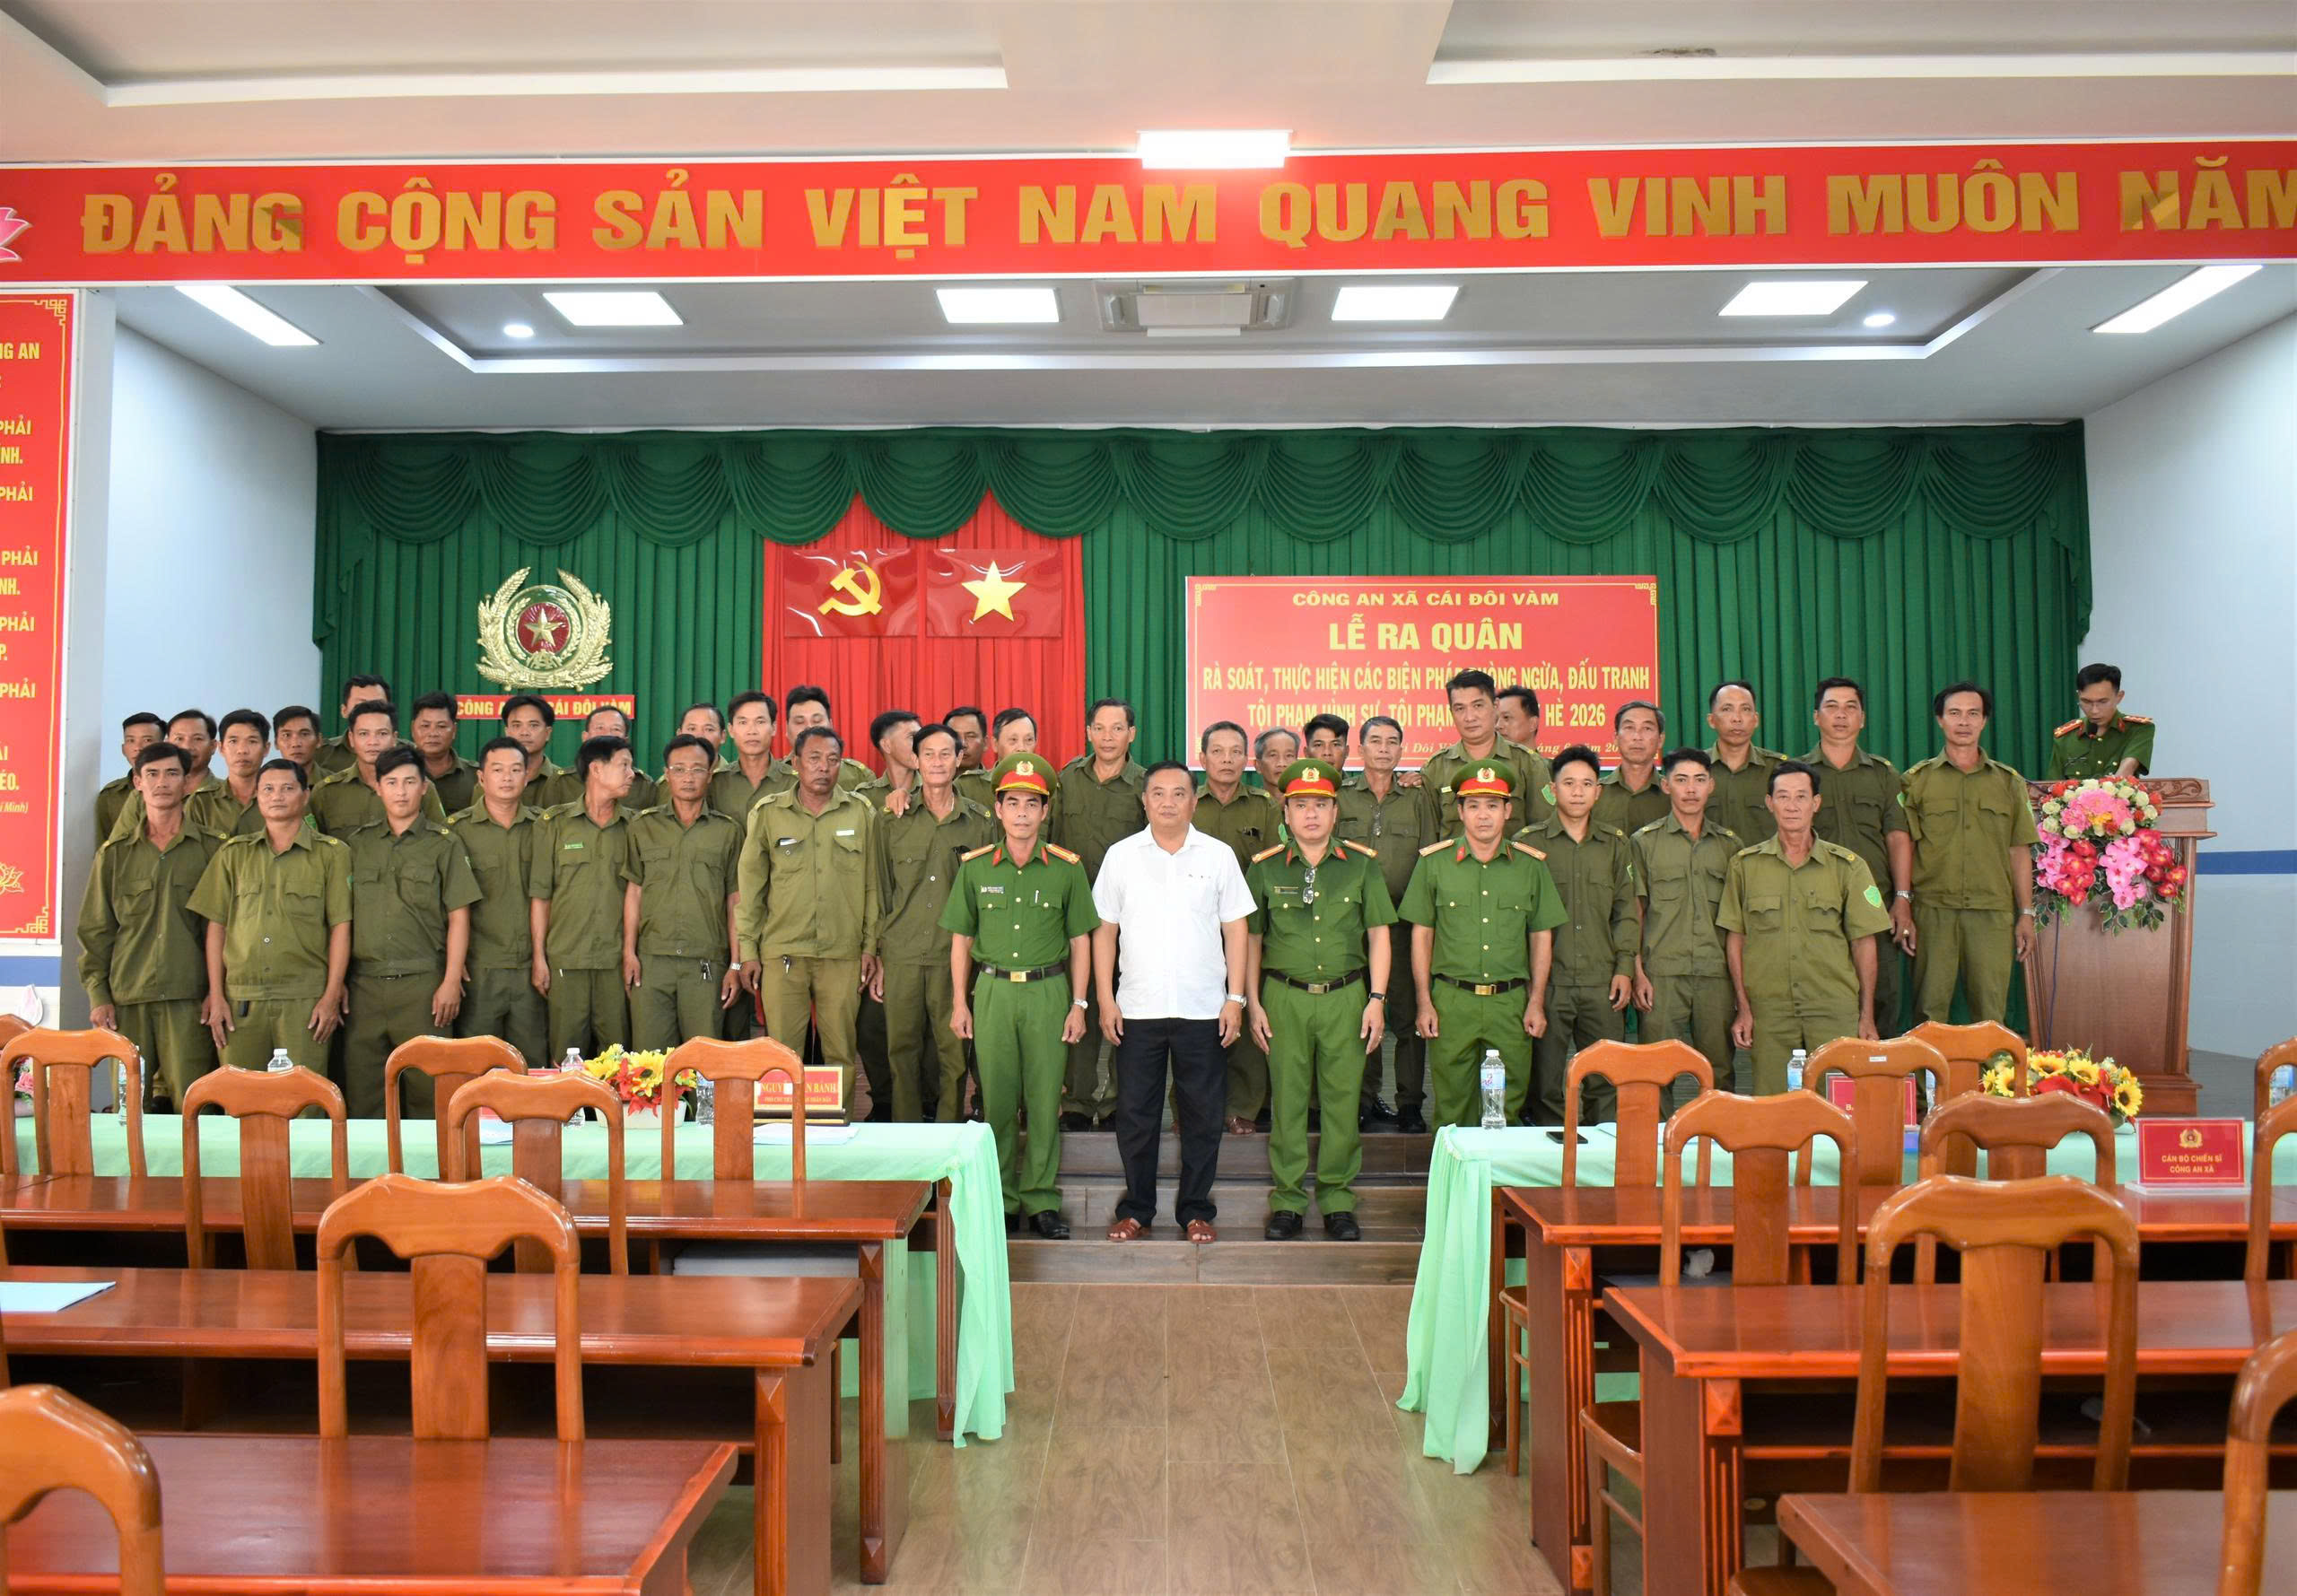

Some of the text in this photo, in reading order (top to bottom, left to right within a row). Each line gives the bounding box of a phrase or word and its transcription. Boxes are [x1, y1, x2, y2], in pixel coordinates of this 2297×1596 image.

[82, 155, 2297, 264] ĐẢNG CỘNG SẢN VIỆT NAM QUANG VINH MUÔN NĂM
[18, 342, 40, 359] AN
[0, 481, 33, 501] PHẢI
[2, 545, 38, 565] PHẢI
[1292, 590, 1559, 606] CÔNG AN XÃ CÁI ĐÔI VÀM
[0, 611, 35, 632] PHẢI
[1329, 613, 1523, 653] LỄ RA QUÂN
[1203, 661, 1223, 690] RÀ
[1227, 661, 1270, 693] SOÁT,
[1273, 663, 1312, 694] THỰC
[1315, 661, 1350, 694] HIỆN
[1354, 661, 1383, 690] CÁC
[1387, 661, 1421, 694] BIỆN
[1521, 659, 1564, 694] NGỪA,
[1568, 657, 1597, 690] ĐẤU
[1602, 667, 1650, 690] TRANH
[0, 677, 36, 698] PHẢI
[457, 699, 493, 716] CÔNG
[1247, 698, 1271, 730] TỘI
[1276, 703, 1318, 732] PHẠM
[1545, 697, 1564, 727] HÈ
[1569, 702, 1606, 727] 2026
[1536, 742, 1560, 754] áng
